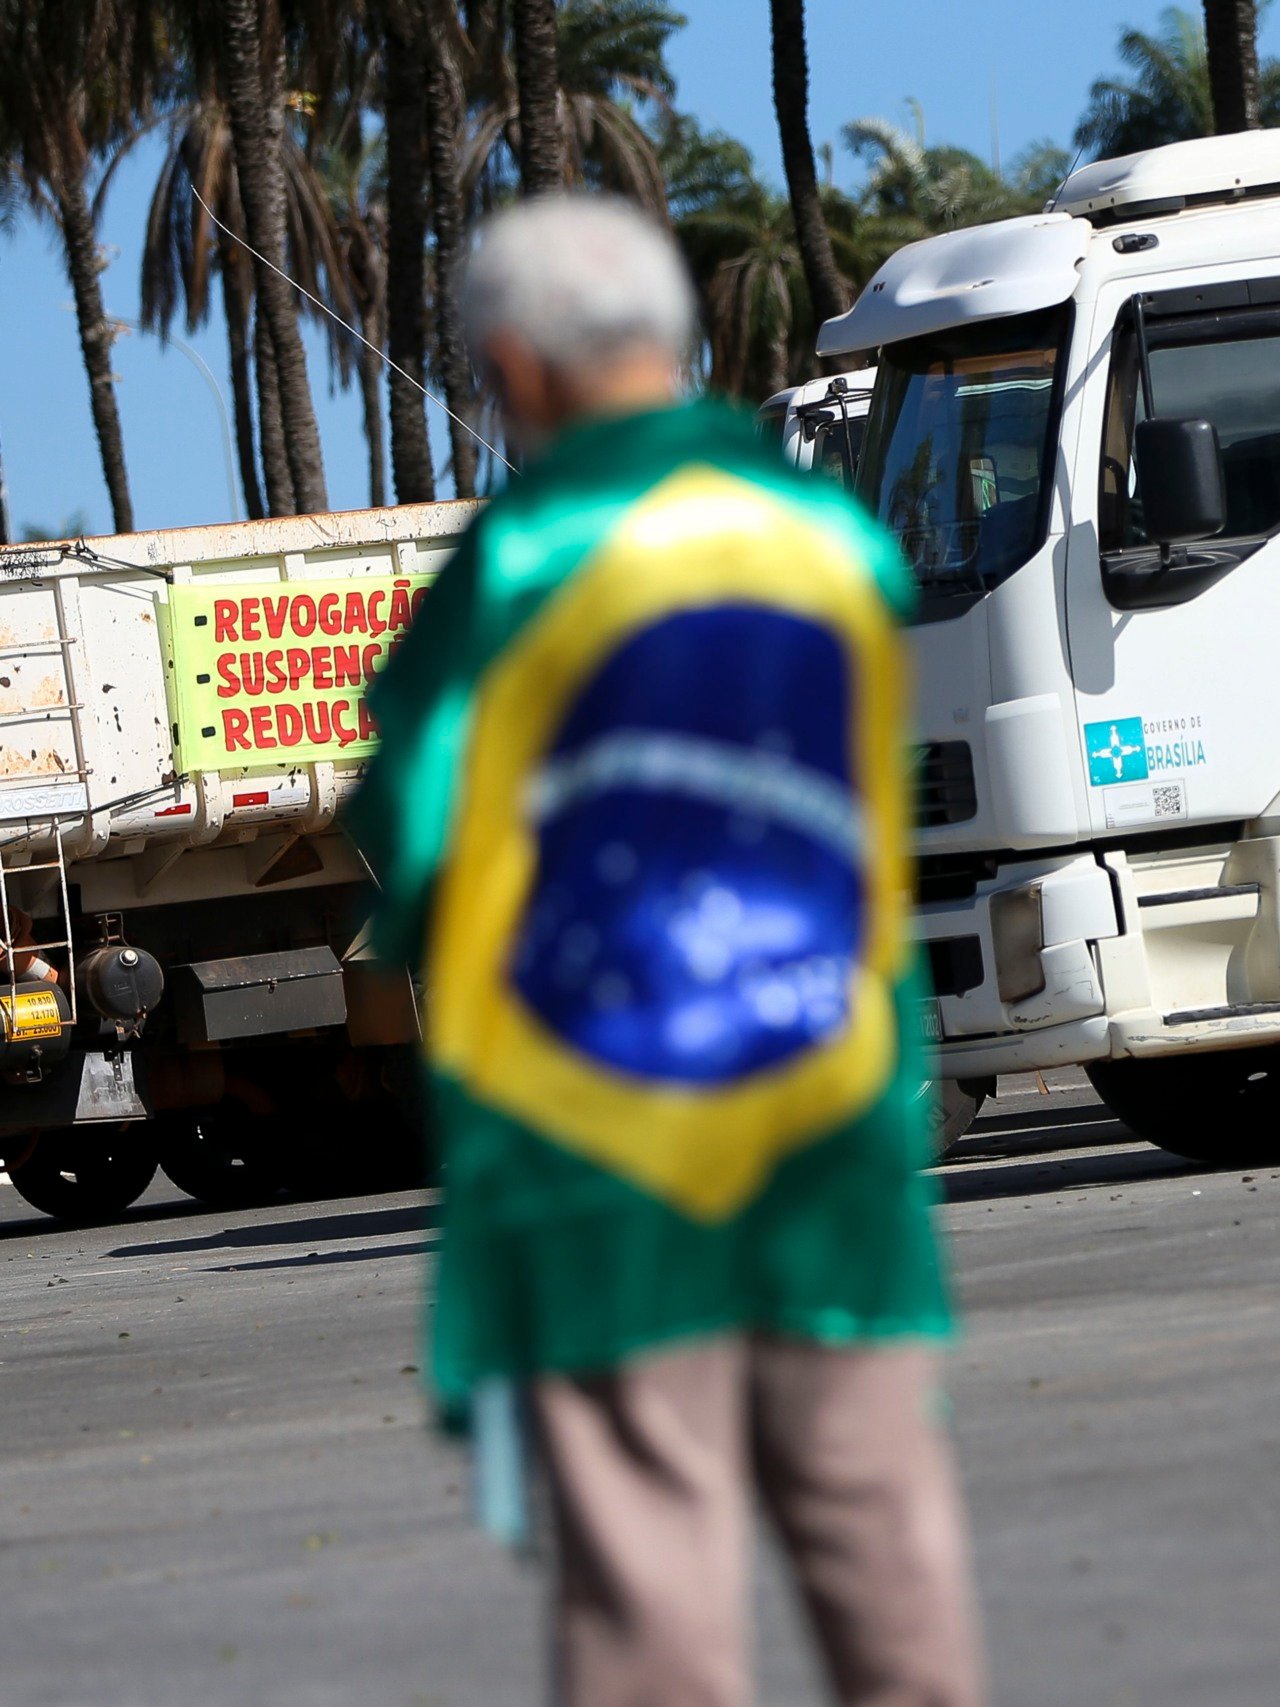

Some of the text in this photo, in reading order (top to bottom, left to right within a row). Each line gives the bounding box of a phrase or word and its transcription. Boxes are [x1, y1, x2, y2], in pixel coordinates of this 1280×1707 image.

[1143, 716, 1202, 734] GOVERNO DE
[1147, 735, 1207, 771] BRASÍLIA
[27, 996, 51, 1007] 10.830
[31, 1008, 55, 1020] 12.170
